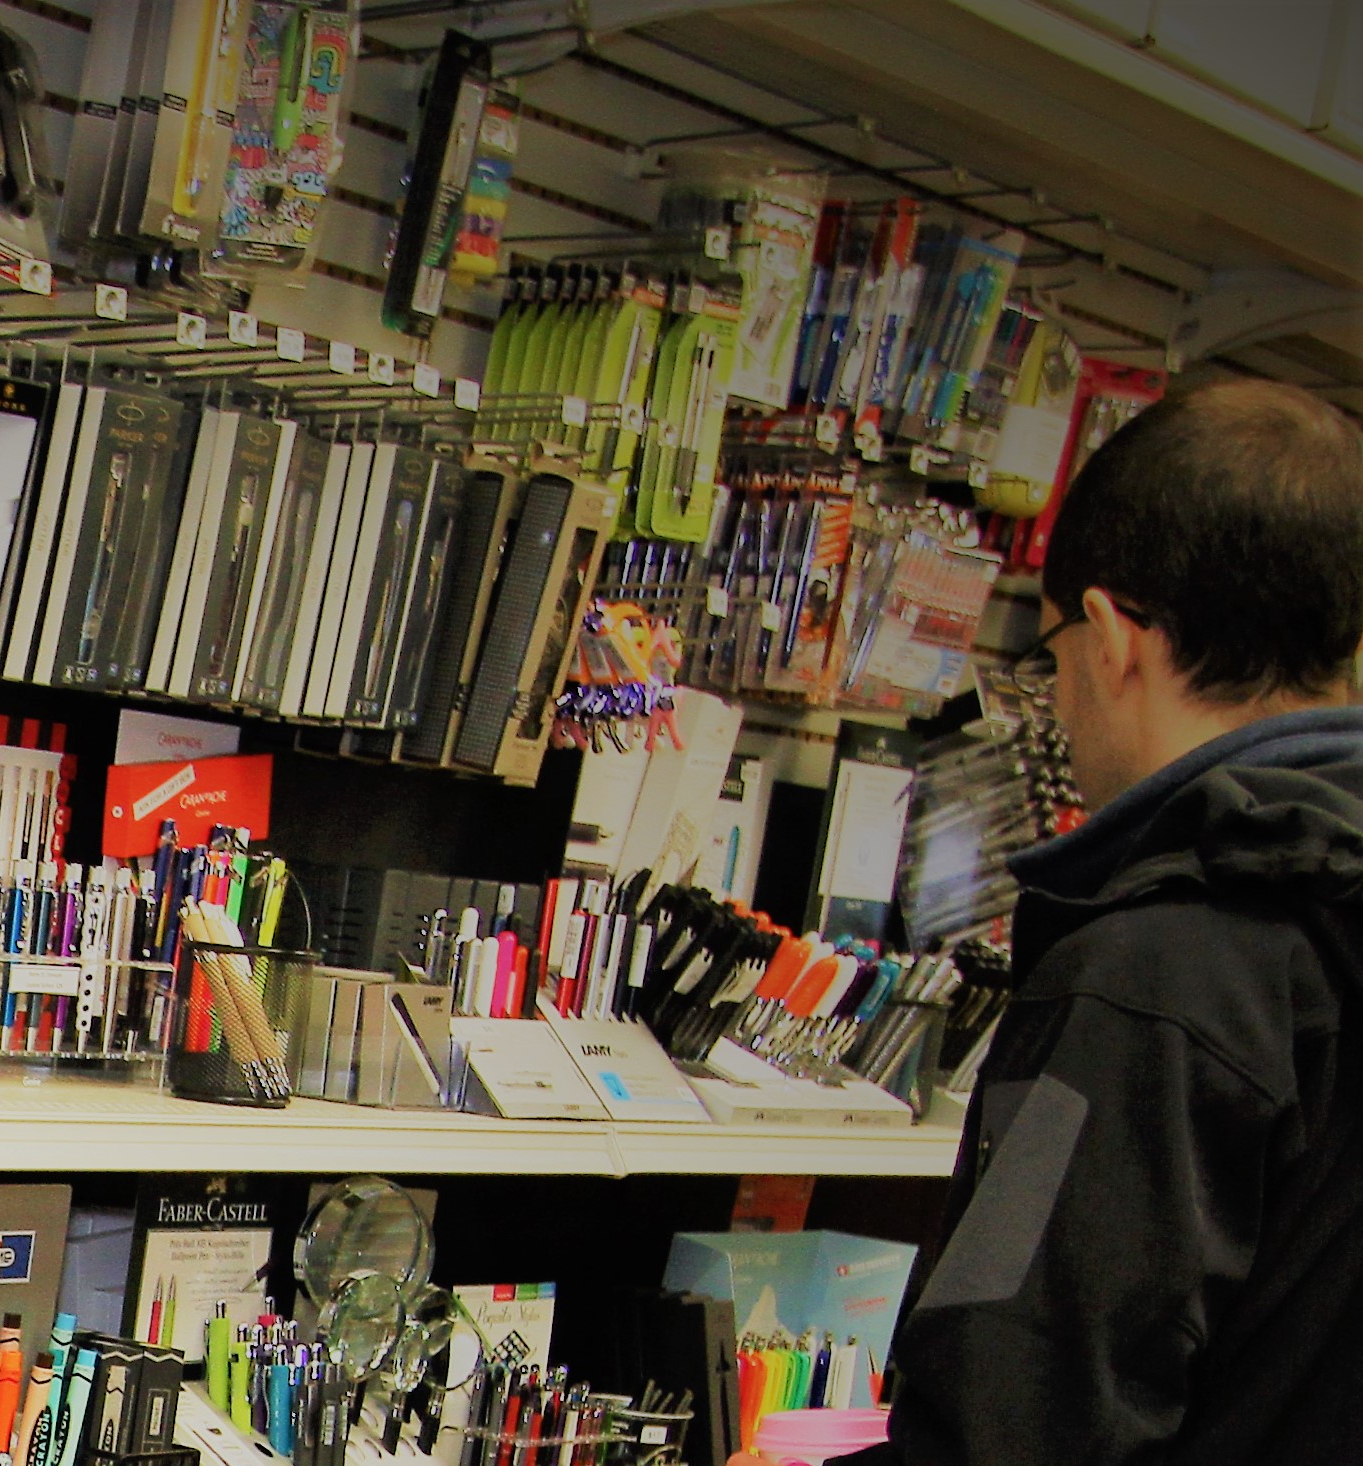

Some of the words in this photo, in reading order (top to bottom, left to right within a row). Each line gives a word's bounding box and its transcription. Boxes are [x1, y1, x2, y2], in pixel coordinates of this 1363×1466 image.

[581, 1045, 612, 1057] LAMY
[158, 1196, 268, 1222] FABER-CASTELL
[53, 1409, 71, 1466] CRAYON
